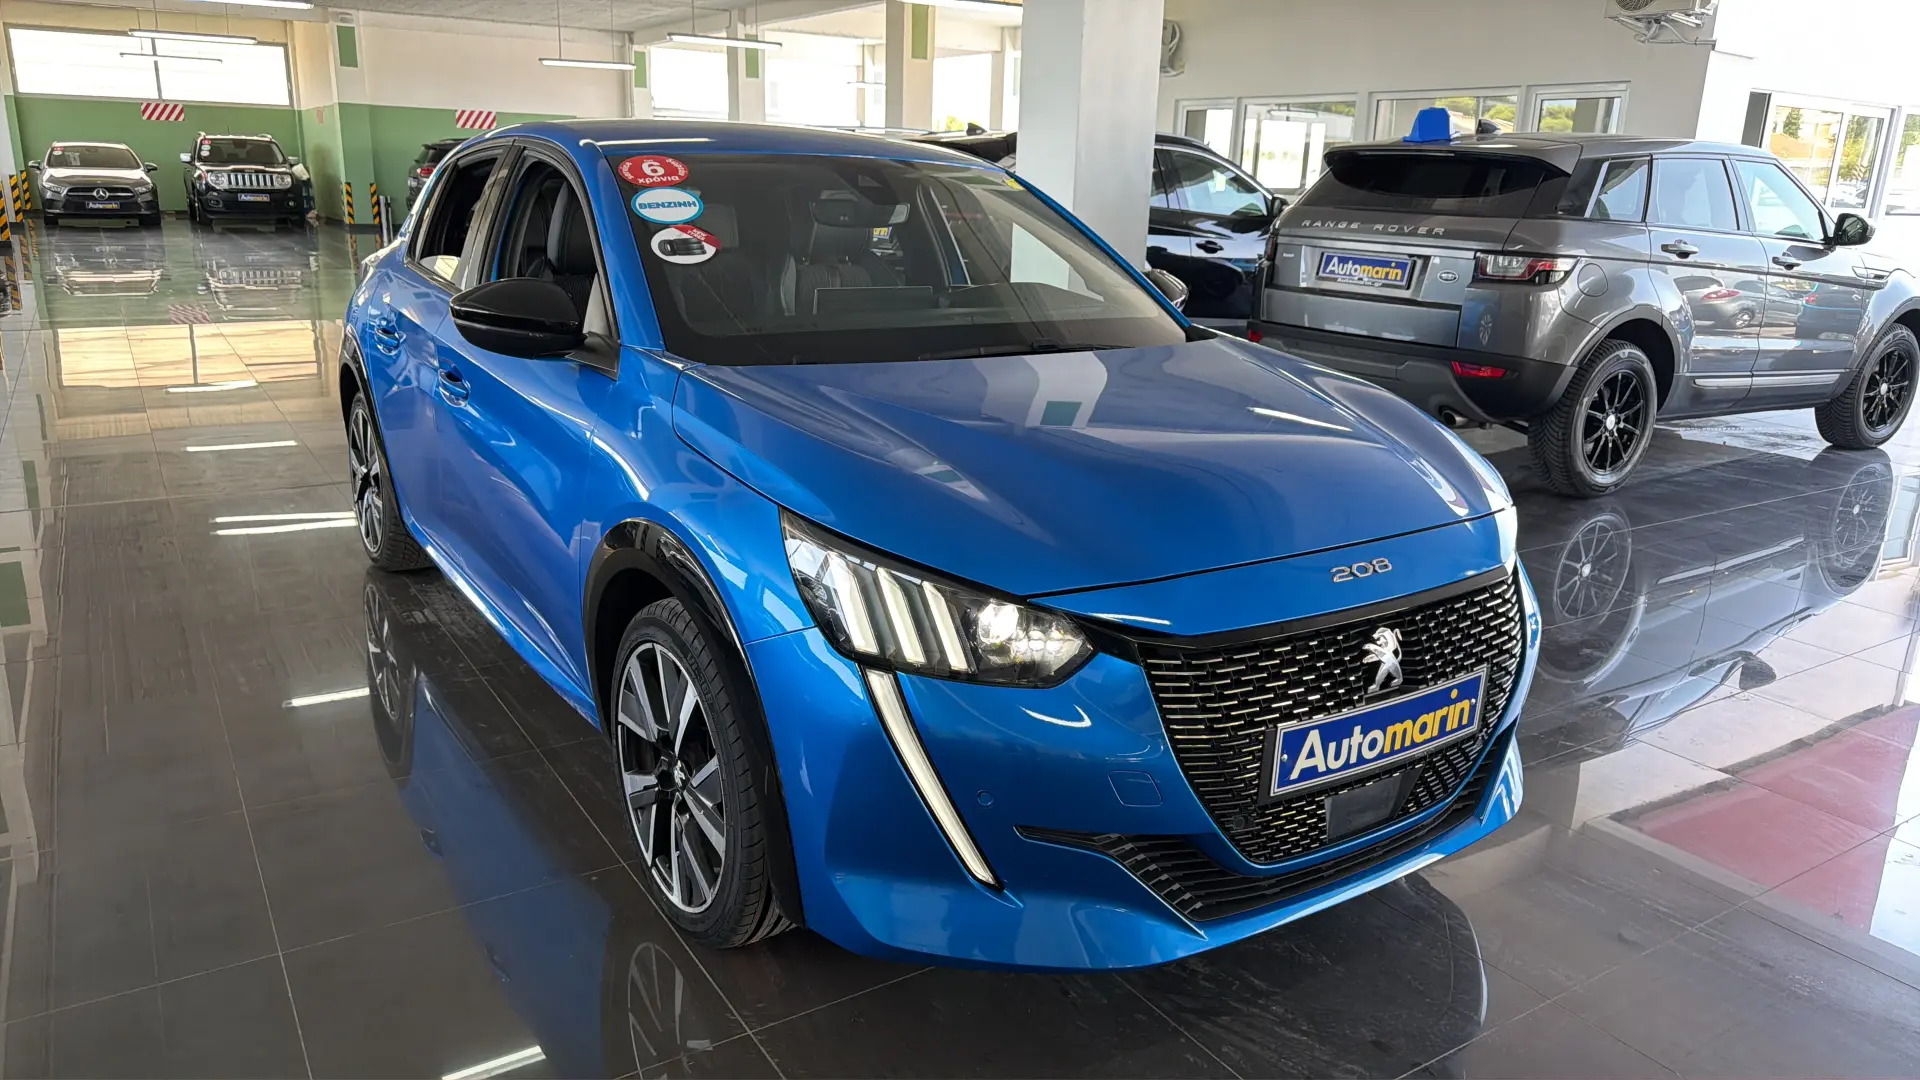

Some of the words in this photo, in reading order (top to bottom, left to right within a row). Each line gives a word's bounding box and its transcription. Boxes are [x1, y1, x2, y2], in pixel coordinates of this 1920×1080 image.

[641, 161, 665, 176] 6
[637, 175, 680, 184] χρόνια
[1301, 219, 1361, 229] RANGE
[1373, 223, 1446, 236] ROVER
[1325, 256, 1402, 281] Automarin
[1330, 557, 1393, 583] 208
[1289, 688, 1472, 781] Automarin
